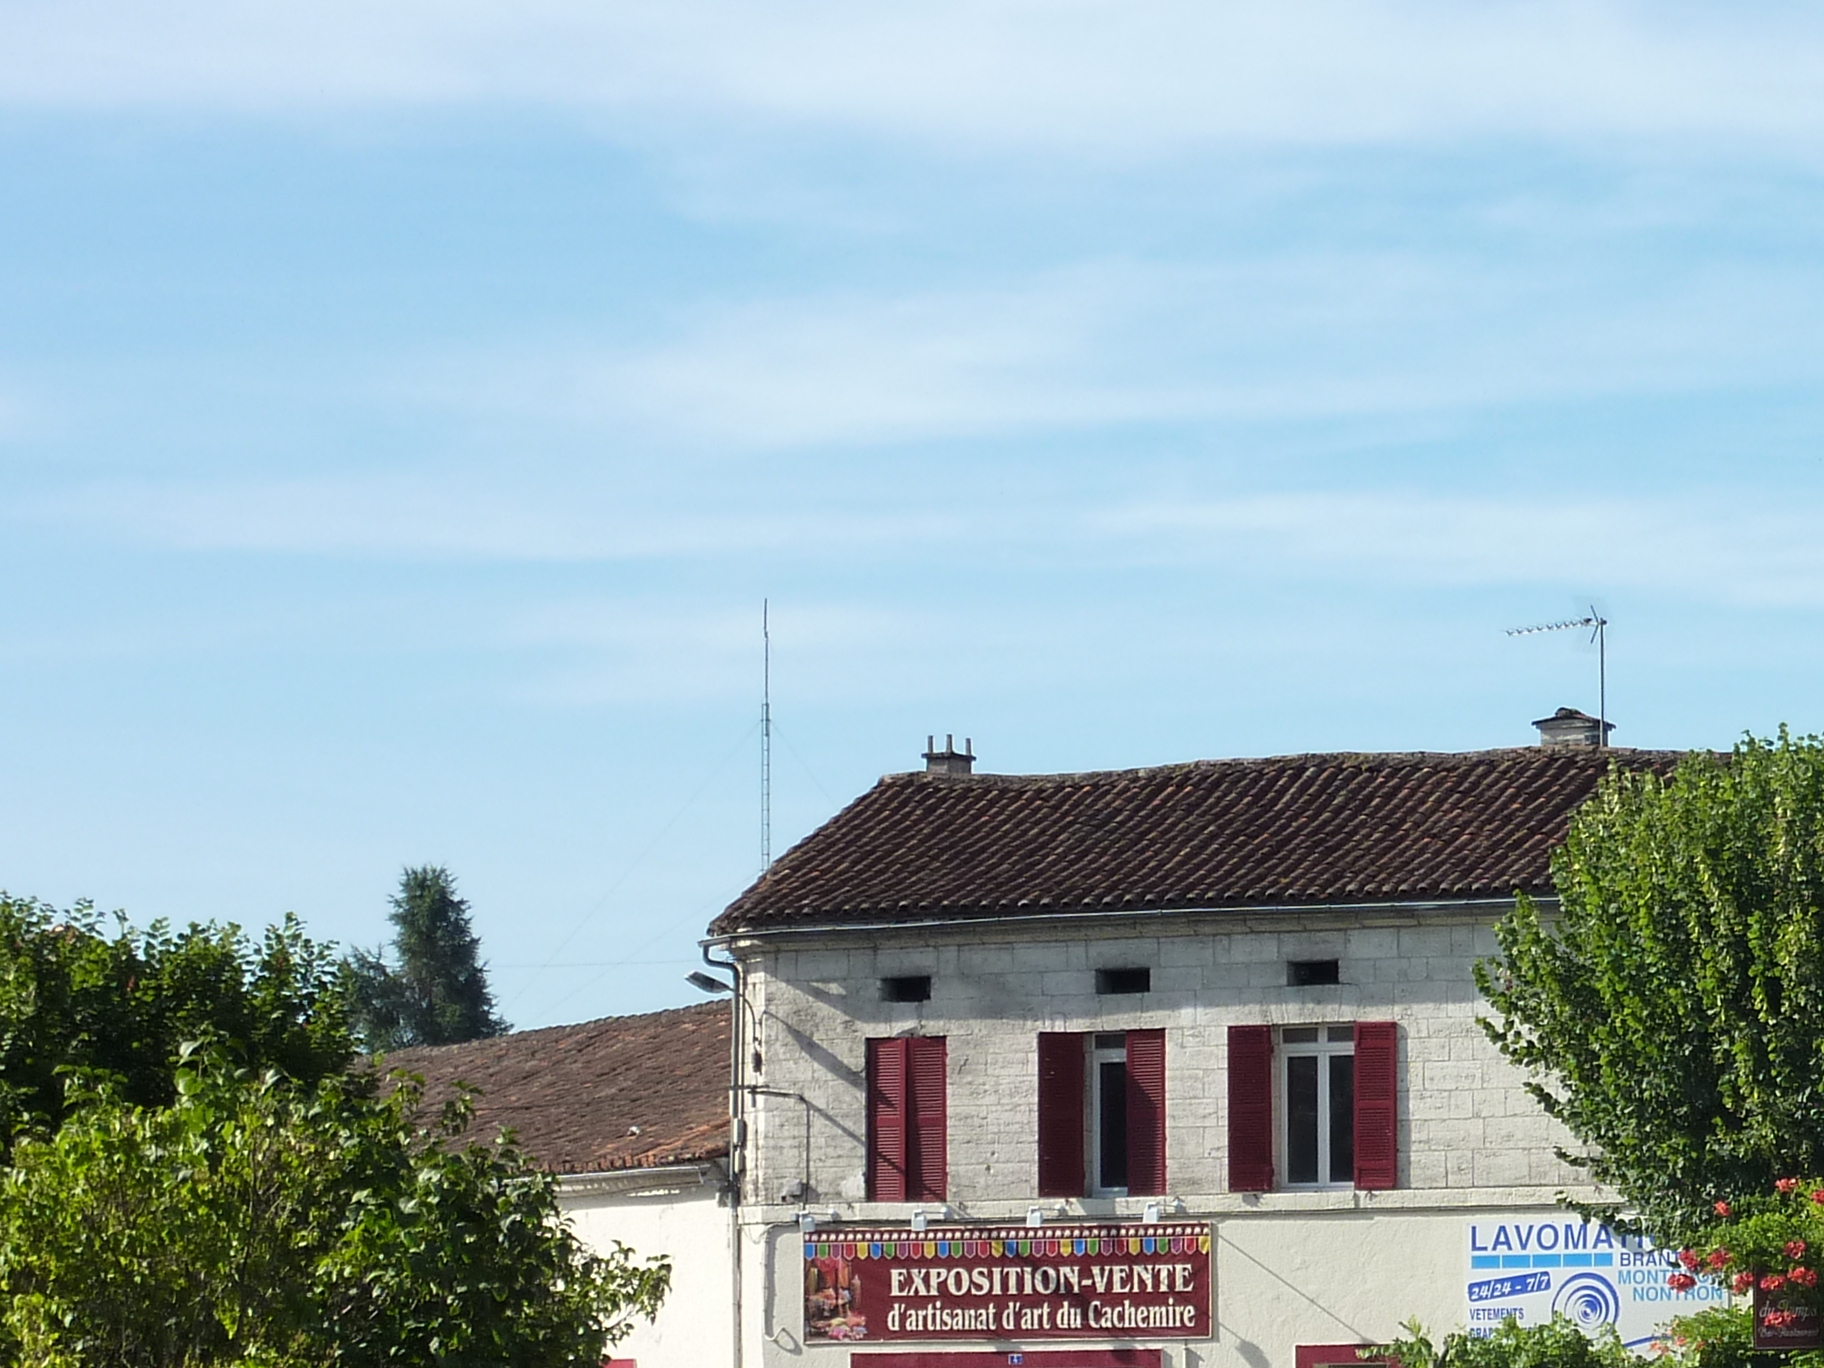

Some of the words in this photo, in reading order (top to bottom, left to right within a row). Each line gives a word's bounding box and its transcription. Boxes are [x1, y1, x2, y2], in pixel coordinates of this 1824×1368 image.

[889, 1263, 1195, 1297] EXPOSITION-VENTE
[1470, 1280, 1512, 1300] 24/24
[1526, 1272, 1549, 1292] 7/7
[886, 1302, 997, 1333] d'artisanat
[1002, 1300, 1051, 1332] d'art
[1055, 1300, 1082, 1330] du
[1086, 1297, 1196, 1330] Cachemire
